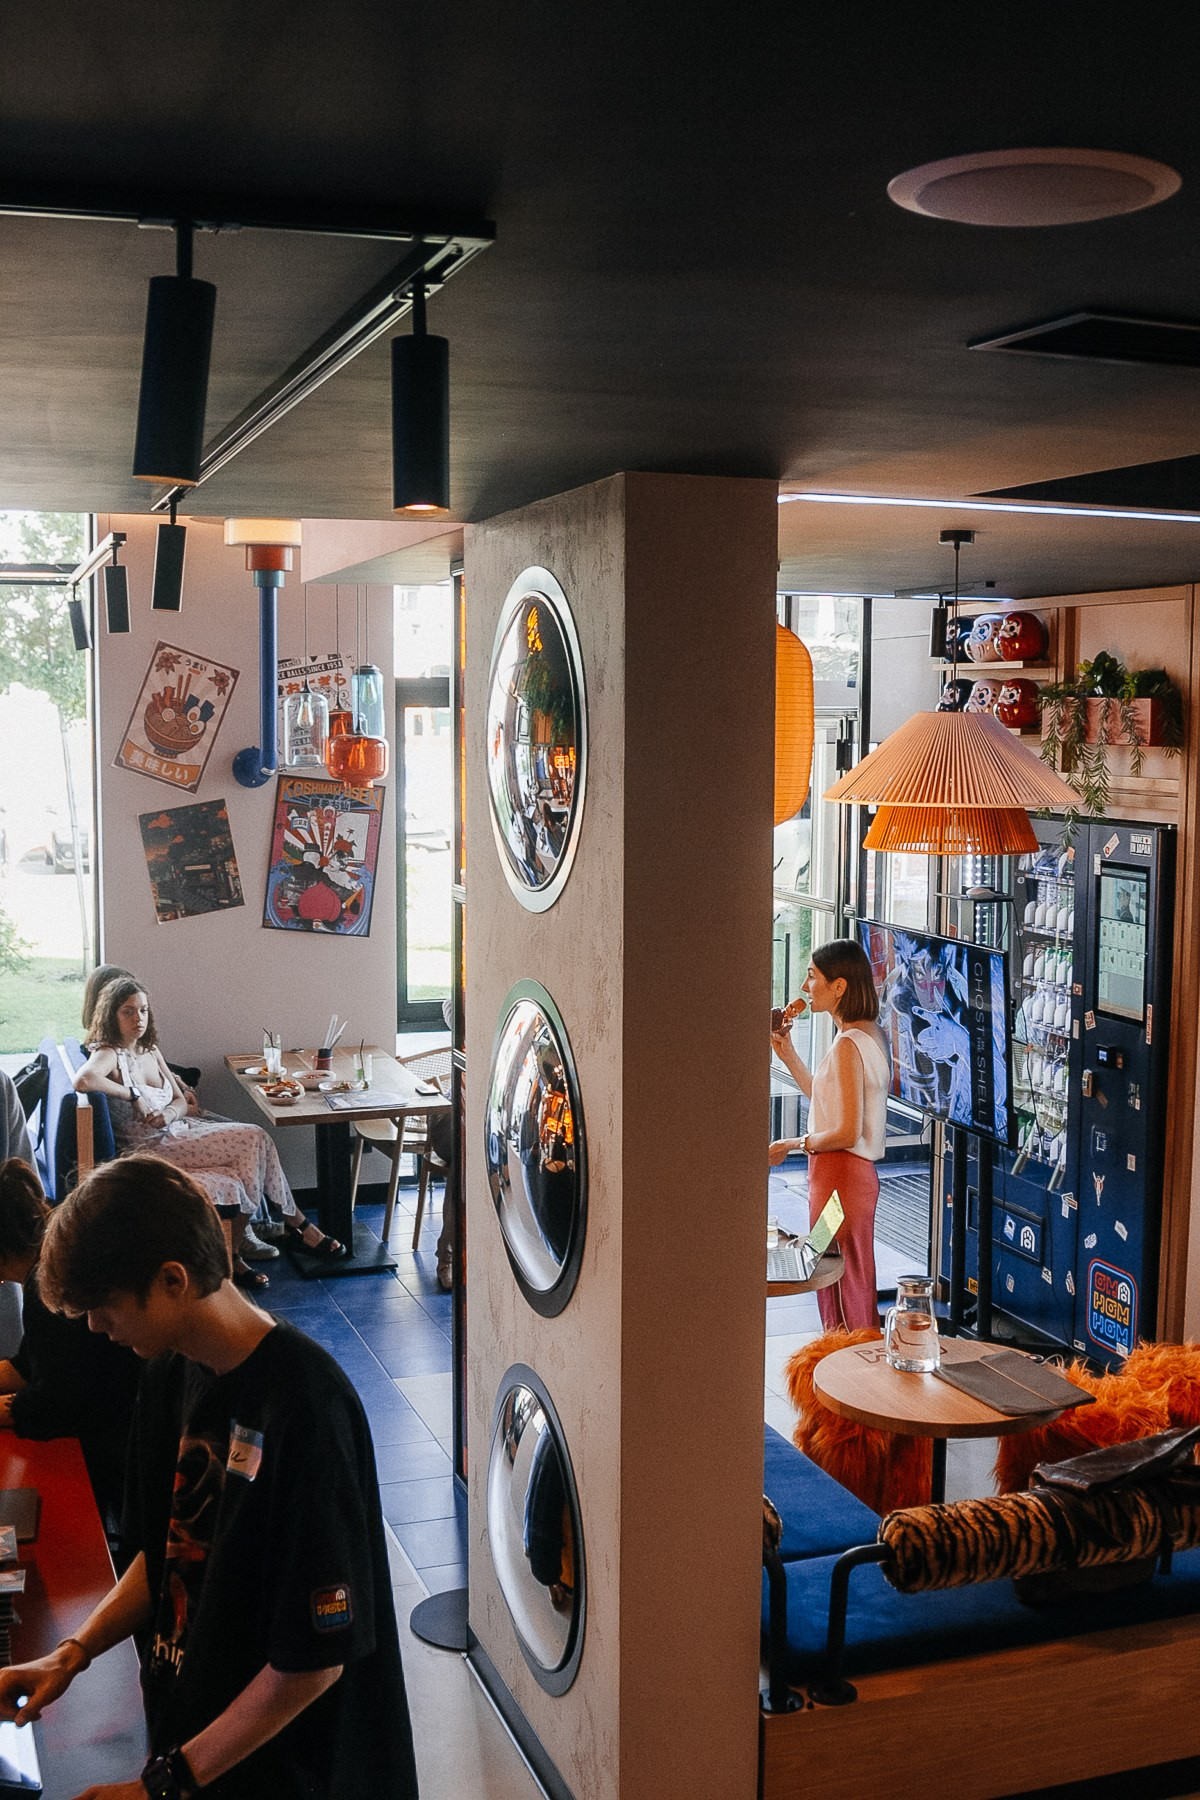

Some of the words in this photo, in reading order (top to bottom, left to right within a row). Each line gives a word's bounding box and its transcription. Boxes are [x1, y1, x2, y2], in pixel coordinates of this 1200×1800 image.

[286, 668, 306, 677] BALLS
[307, 664, 326, 674] SINCE
[129, 749, 188, 780] 美味しい
[974, 962, 985, 1037] GHOST
[976, 1057, 988, 1120] SHELL
